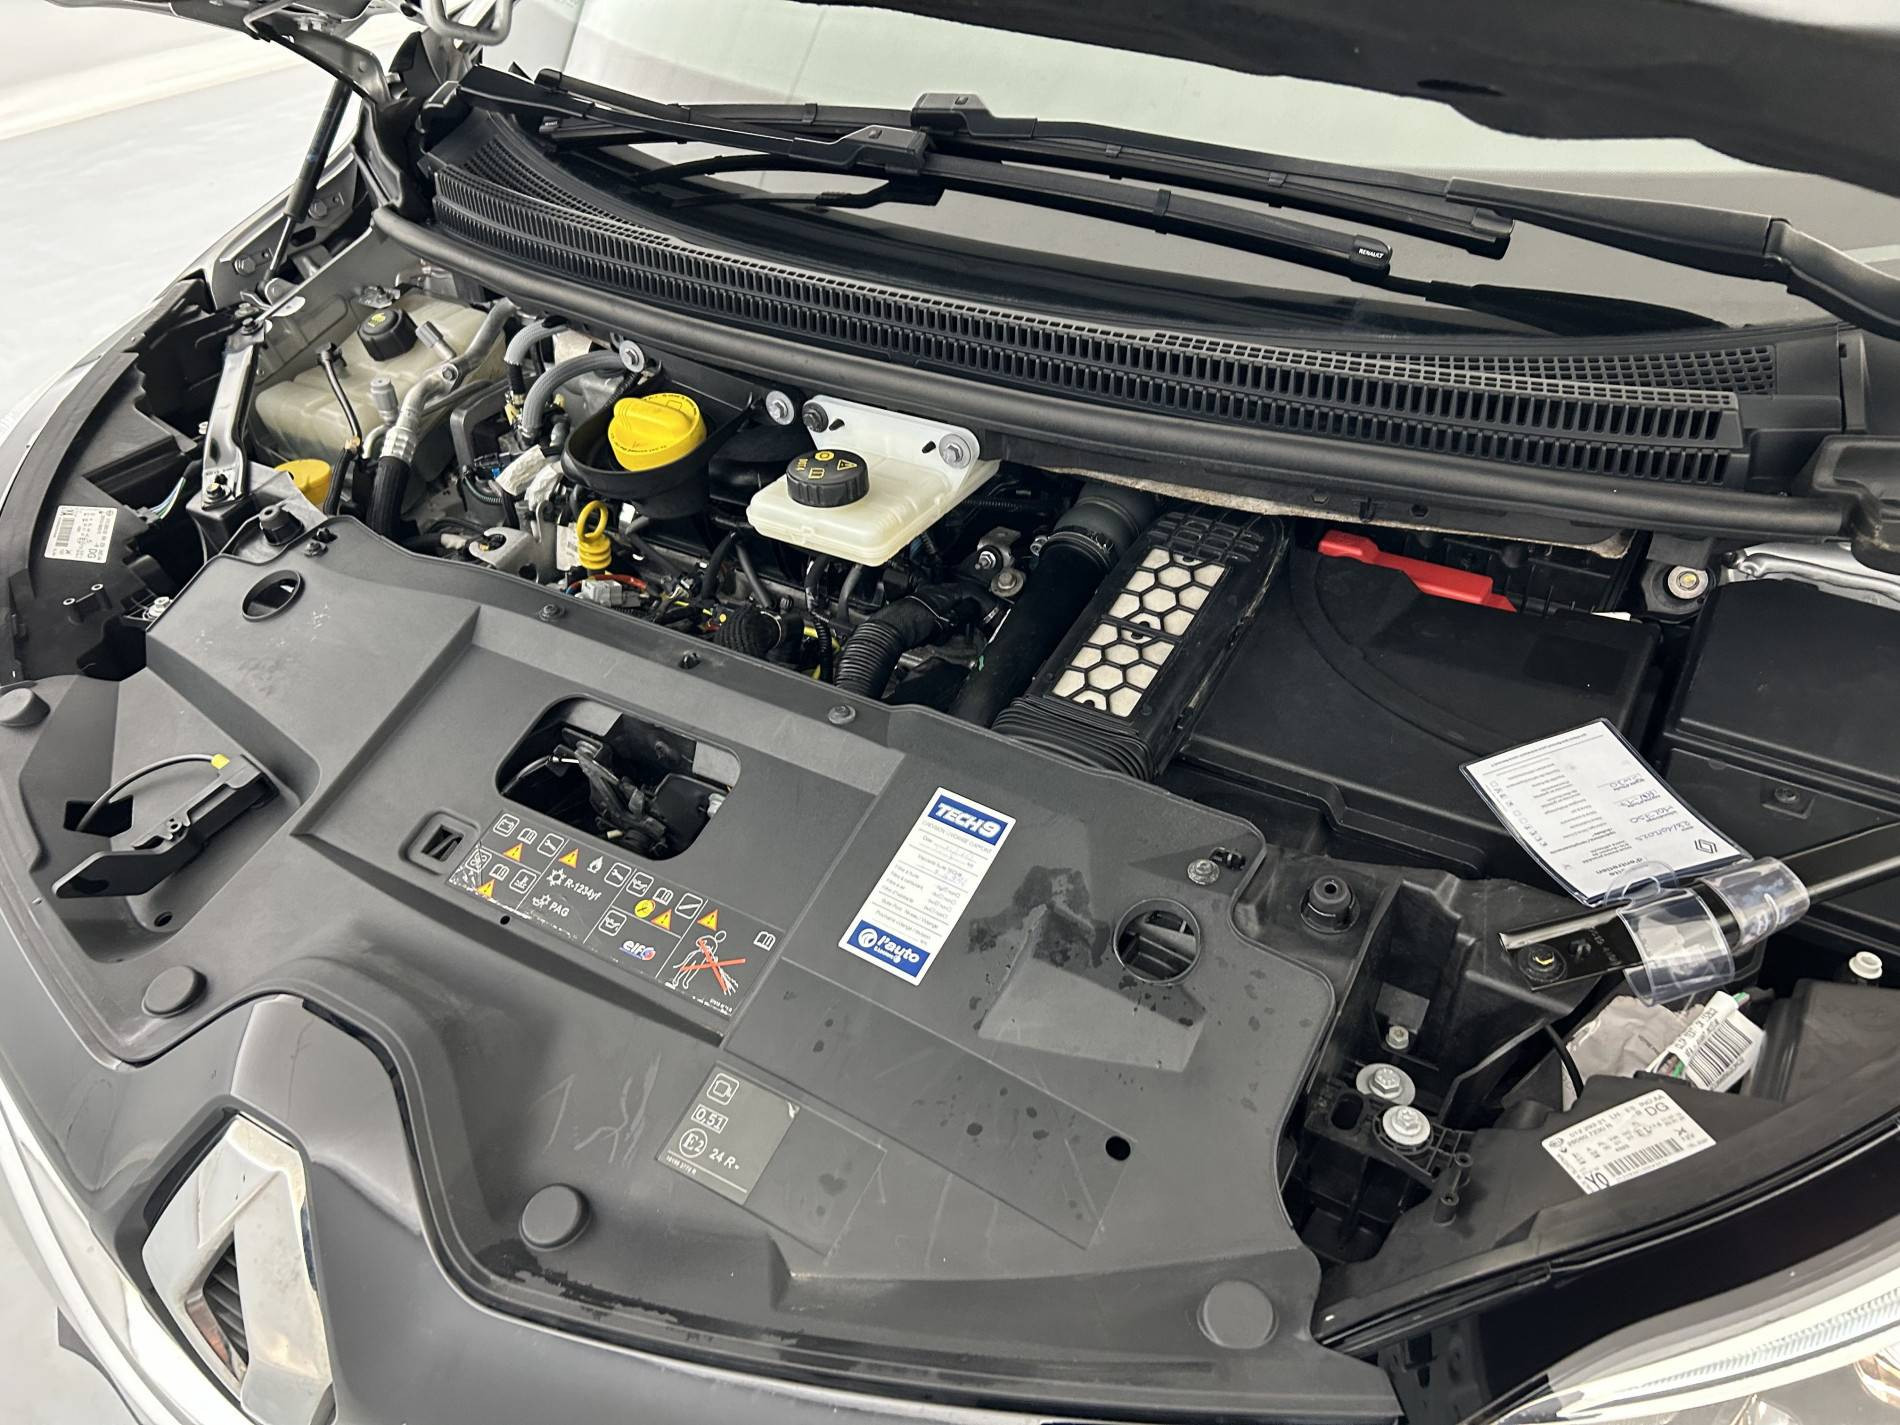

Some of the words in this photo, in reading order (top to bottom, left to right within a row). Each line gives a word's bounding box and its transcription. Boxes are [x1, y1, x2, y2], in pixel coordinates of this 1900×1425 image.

[1359, 248, 1384, 259] RENAULT
[935, 802, 1001, 838] TECH9
[564, 878, 602, 901] R-1234yf
[549, 901, 570, 917] PAG
[622, 940, 646, 955] elf
[1644, 1101, 1669, 1117] DG
[695, 1108, 723, 1130] 0,51
[682, 1133, 705, 1153] E2
